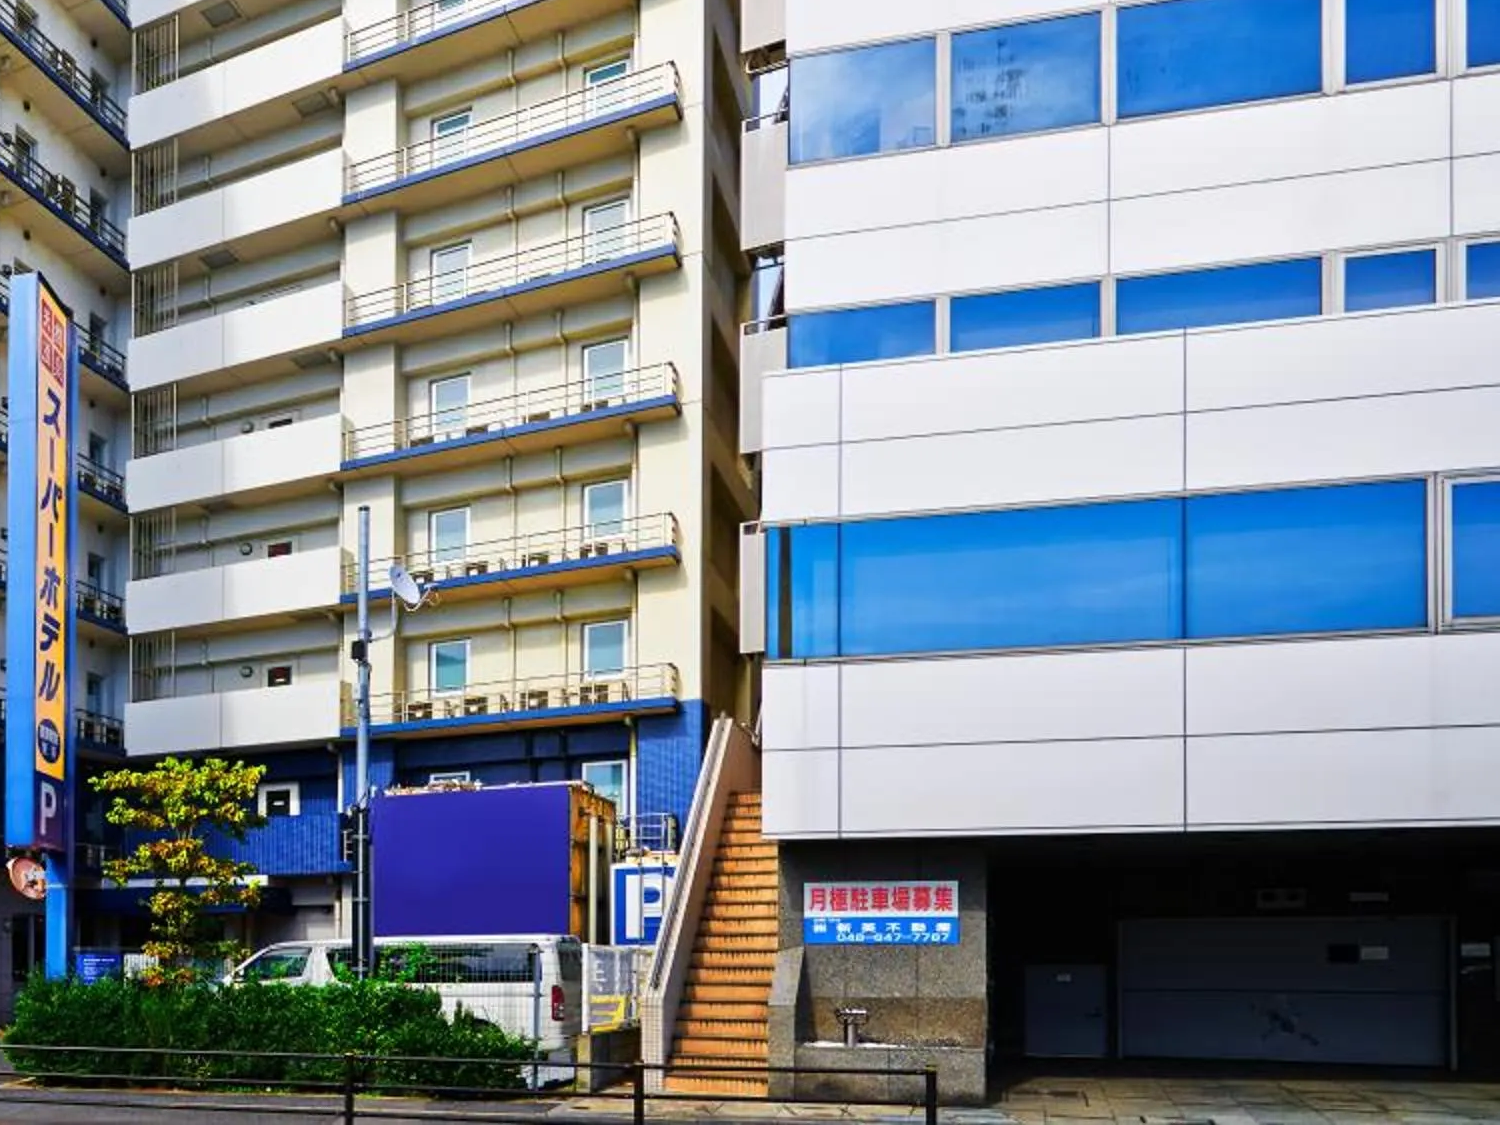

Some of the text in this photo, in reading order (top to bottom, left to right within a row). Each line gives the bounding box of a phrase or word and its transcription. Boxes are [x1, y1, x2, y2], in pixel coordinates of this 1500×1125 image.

[38, 386, 63, 702] スーパーホテル
[41, 780, 57, 836] P
[625, 873, 676, 939] P
[810, 885, 954, 912] 月極駐車場募集
